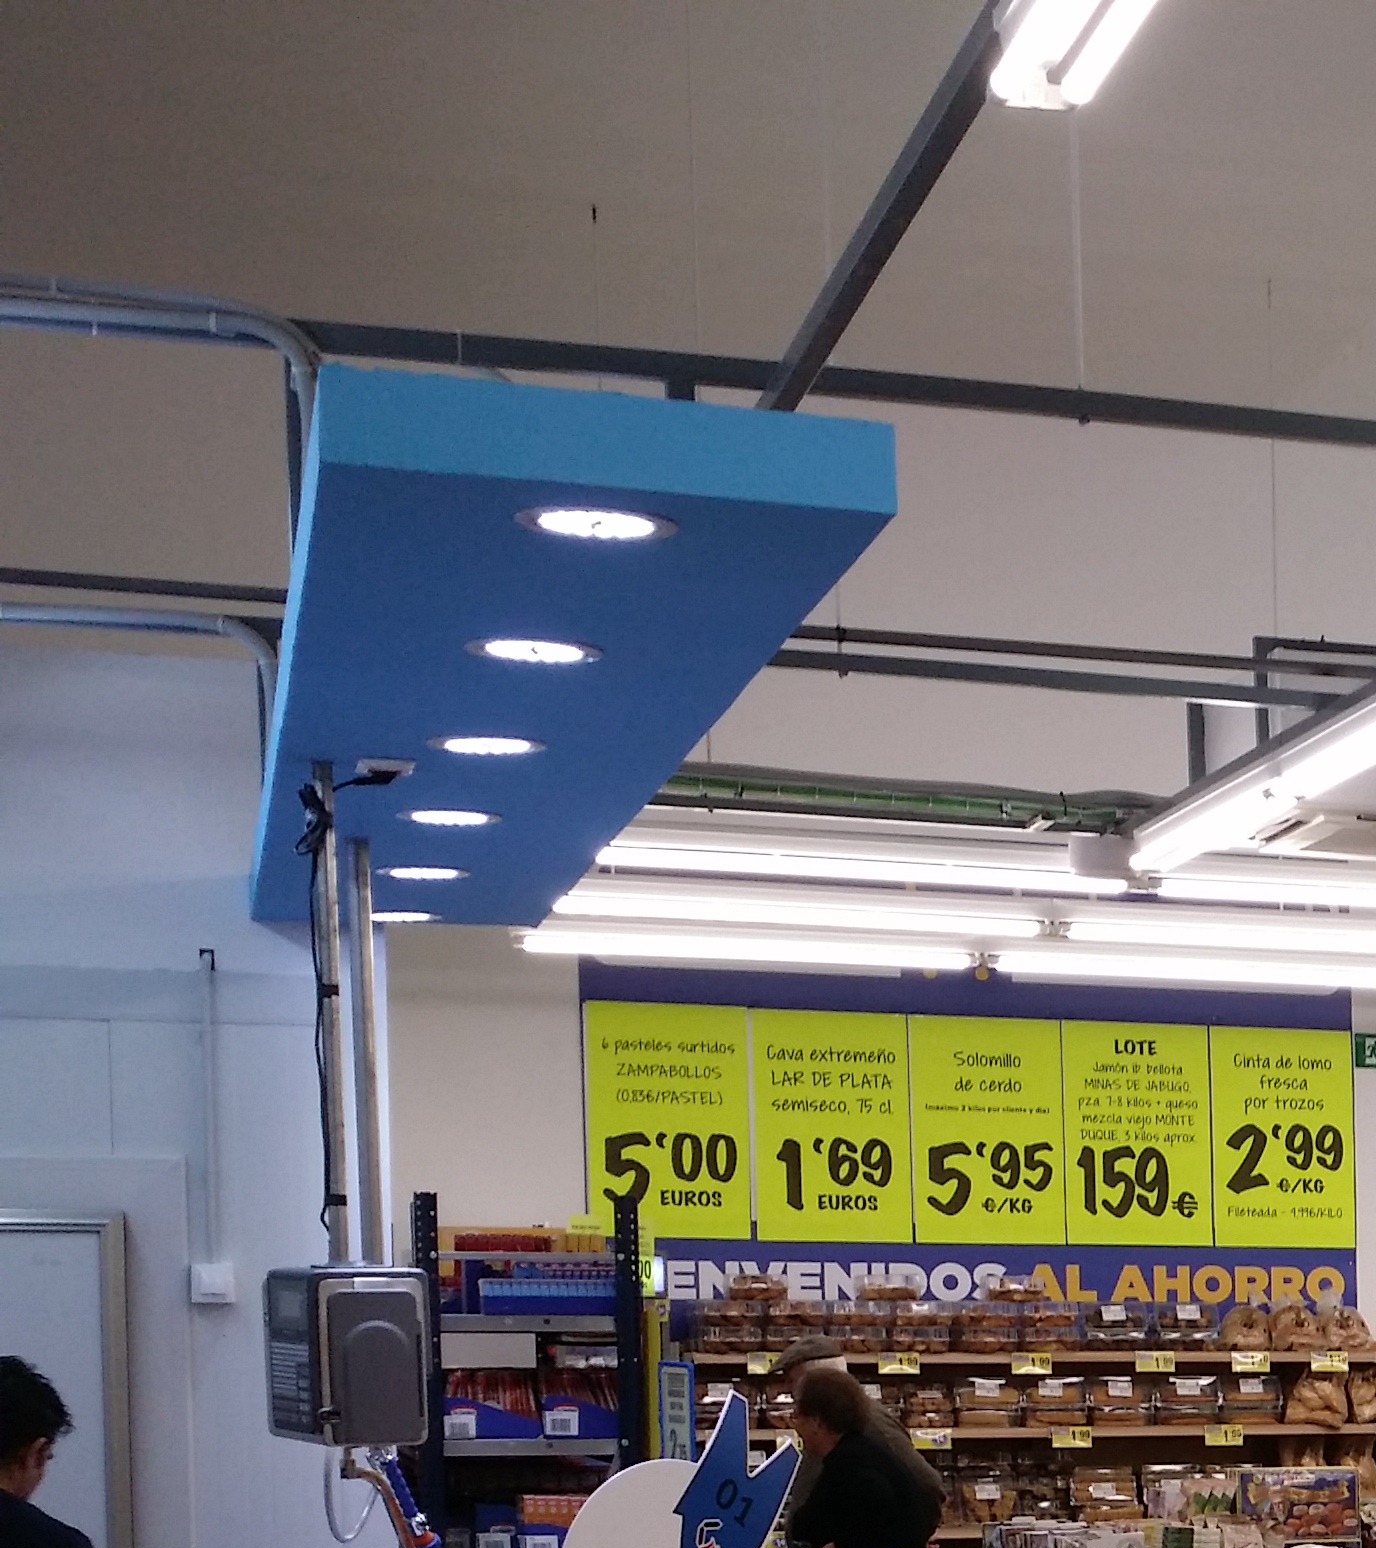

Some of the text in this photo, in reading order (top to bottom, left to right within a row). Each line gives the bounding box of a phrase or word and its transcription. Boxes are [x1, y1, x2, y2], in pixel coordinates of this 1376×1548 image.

[614, 1039, 672, 1055] pasteles
[678, 1041, 735, 1054] surtidos
[767, 1044, 895, 1064] Cava extremeño
[1114, 1039, 1157, 1056] LOTE
[953, 1051, 1021, 1068] Solomillo
[1234, 1053, 1332, 1070] Cinta de lomo
[617, 1063, 721, 1080] ZAMPABOLLOS
[1092, 1062, 1183, 1075] Jamón bellota
[771, 1071, 892, 1090] LAR DE PLATA
[955, 1077, 1022, 1093] de cerdo
[1084, 1078, 1140, 1091] MINAS DE
[1260, 1075, 1308, 1091] fresca
[857, 1098, 872, 1114] 75
[1126, 1097, 1152, 1108] kilos
[1165, 1099, 1198, 1113] queso
[1245, 1096, 1324, 1115] por trozos
[1082, 1113, 1195, 1129] mezcla viejo MONTE
[1134, 1131, 1160, 1142] kilos
[660, 1190, 722, 1207] EUROS
[818, 1195, 878, 1211] EUROS
[1227, 1206, 1278, 1218] Fileteada
[1030, 1264, 1346, 1302] AL AHORRO
